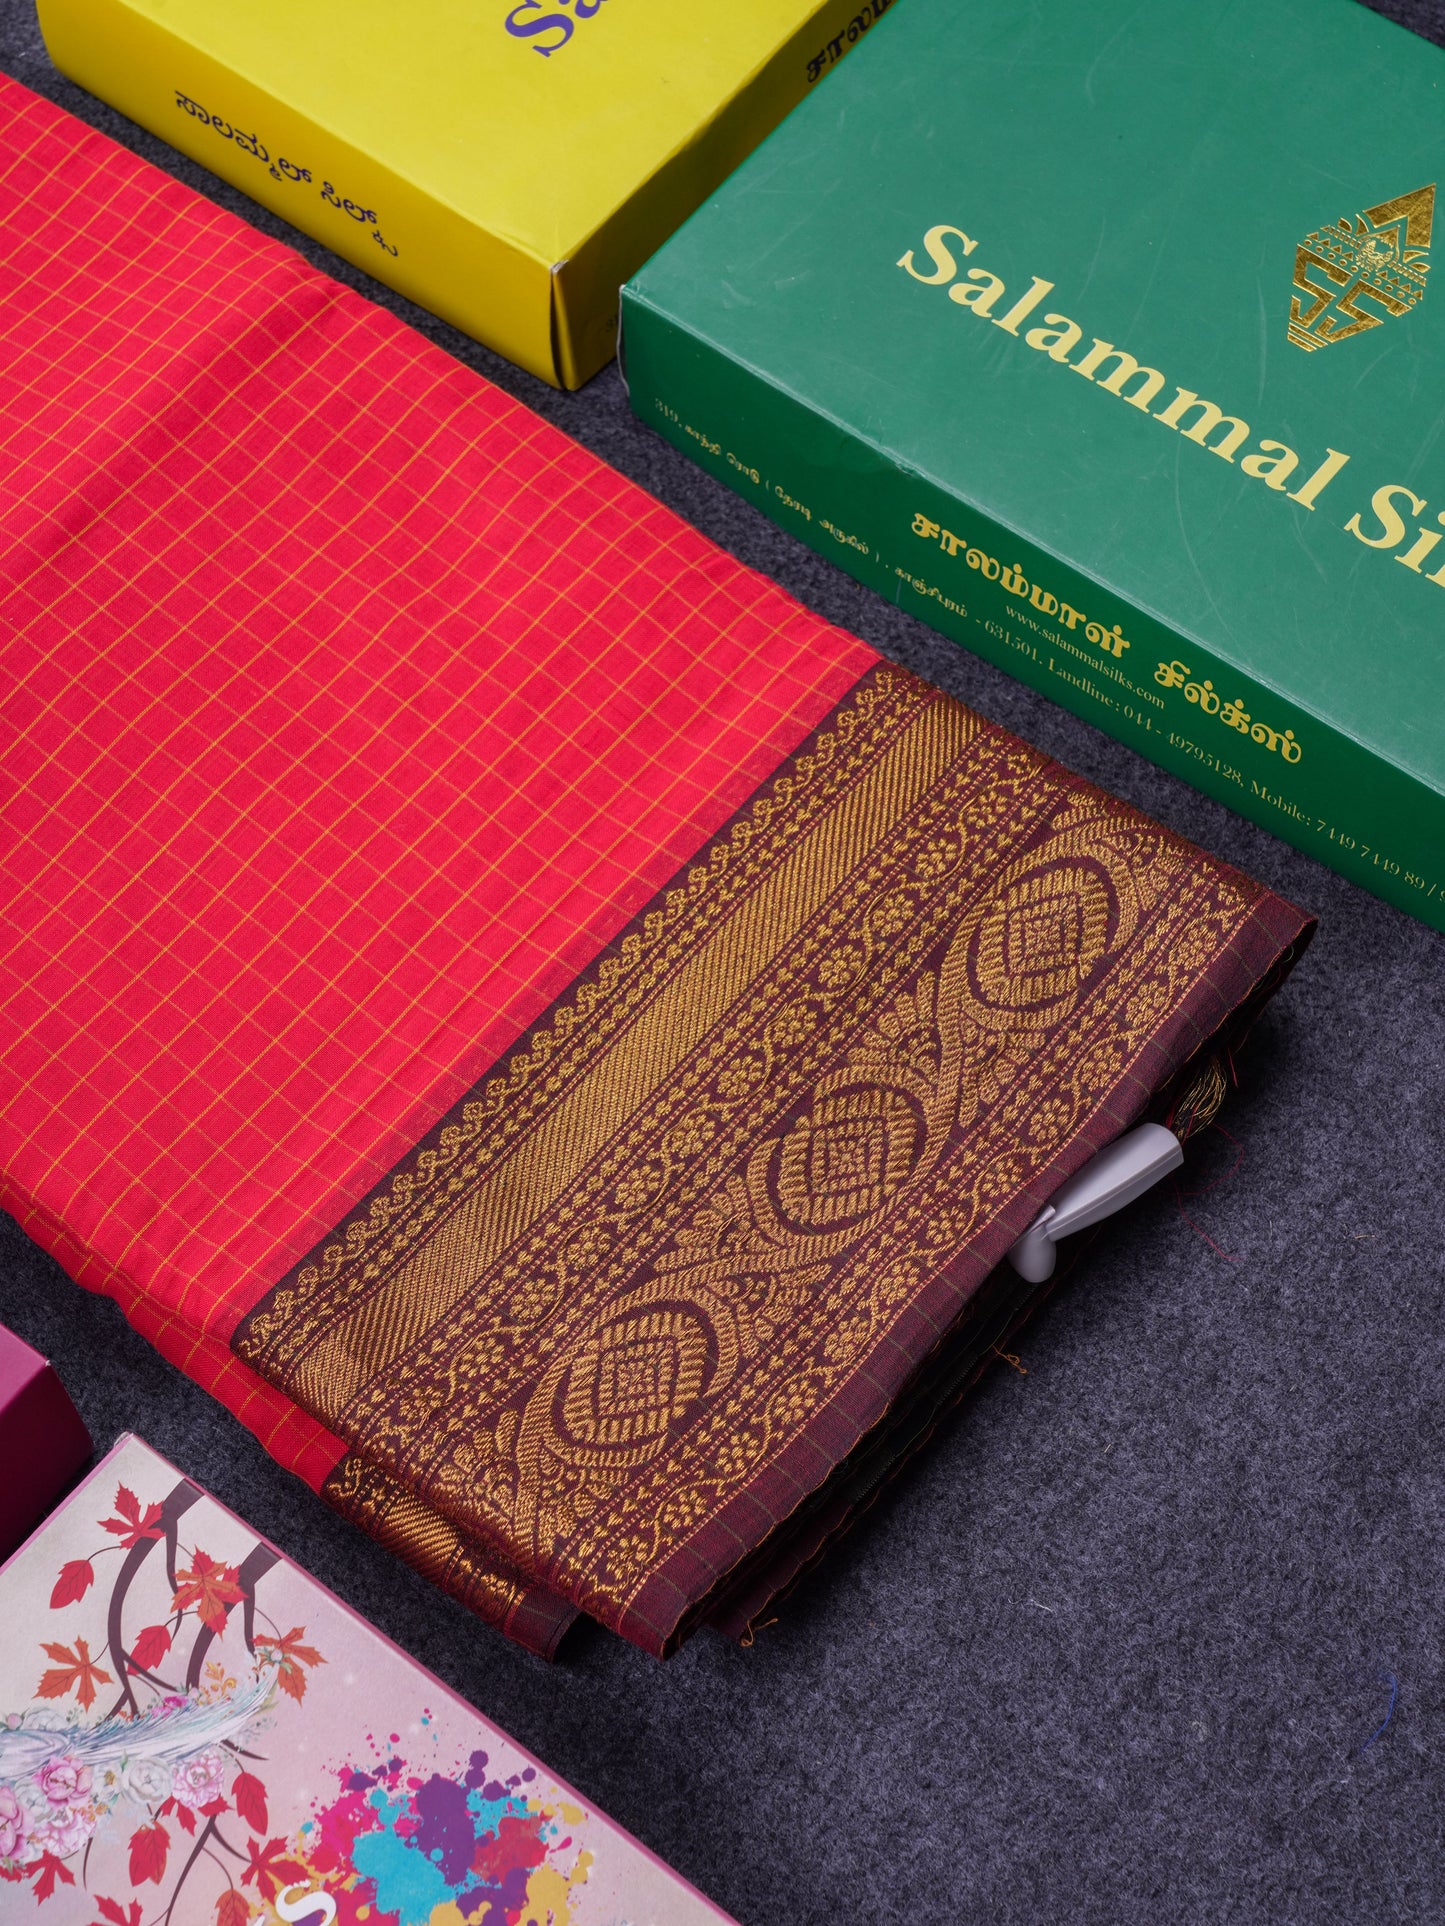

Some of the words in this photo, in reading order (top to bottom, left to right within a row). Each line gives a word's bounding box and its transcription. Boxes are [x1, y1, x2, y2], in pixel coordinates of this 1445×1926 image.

[896, 224, 1351, 512] Salammal
[911, 512, 1131, 658] சாலம்மாள்
[1153, 659, 1303, 765] சில்க்ஸ்
[1005, 604, 1166, 710] www.salammalsilks.com
